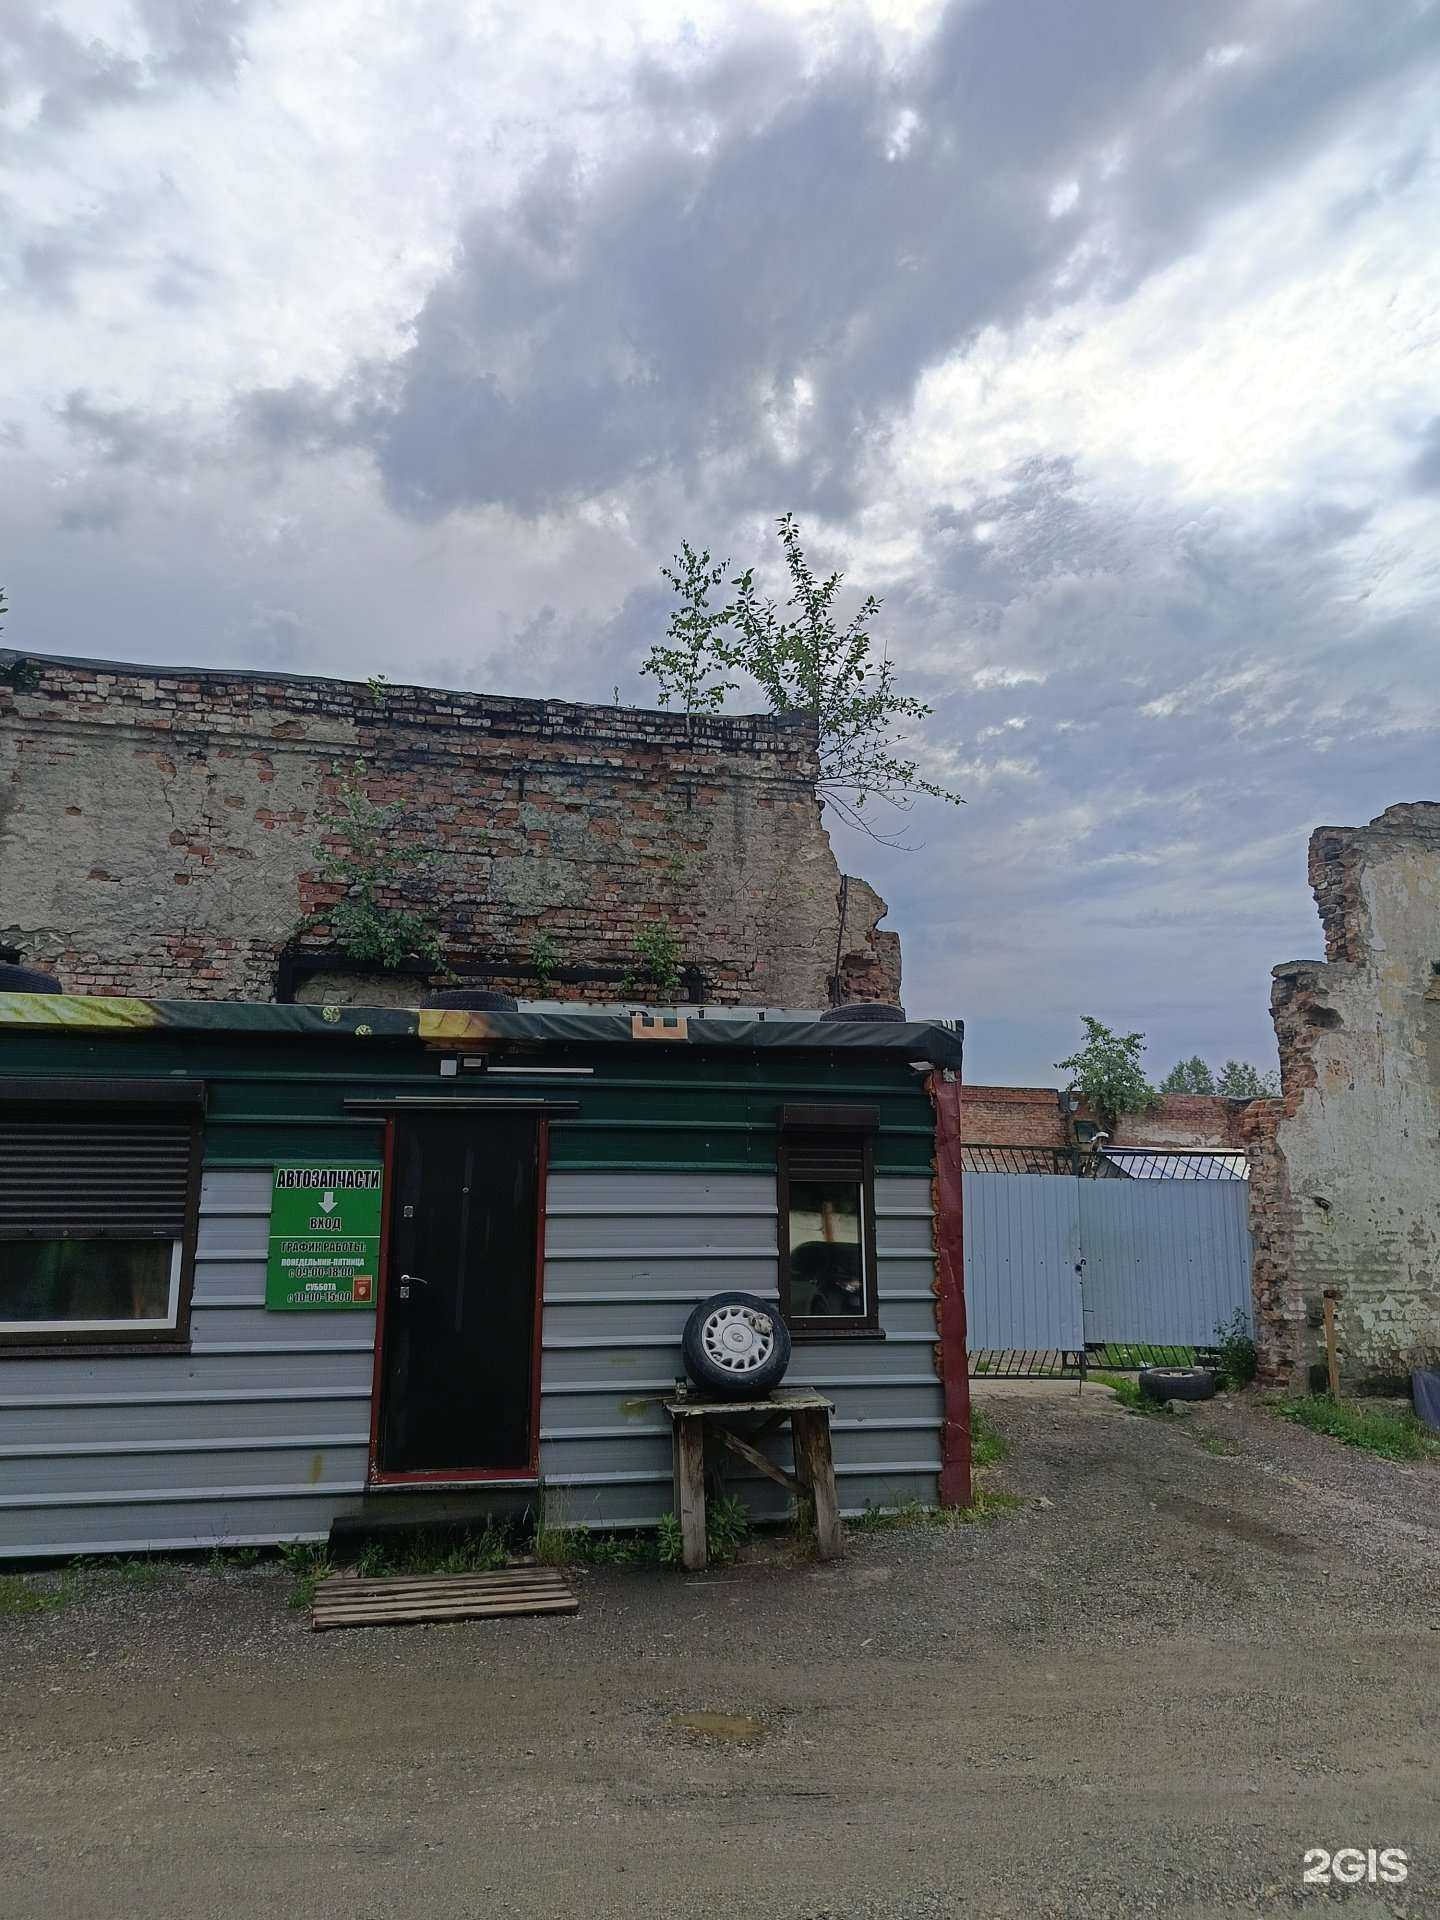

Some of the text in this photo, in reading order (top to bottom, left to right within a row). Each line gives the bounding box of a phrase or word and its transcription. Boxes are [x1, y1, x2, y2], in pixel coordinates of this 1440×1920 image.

[276, 1168, 380, 1189] АВТОЗАПЧАСТИ
[309, 1217, 342, 1231] ВХОД
[281, 1241, 321, 1253] ГРАФИК
[305, 1283, 337, 1291] СУББОТА
